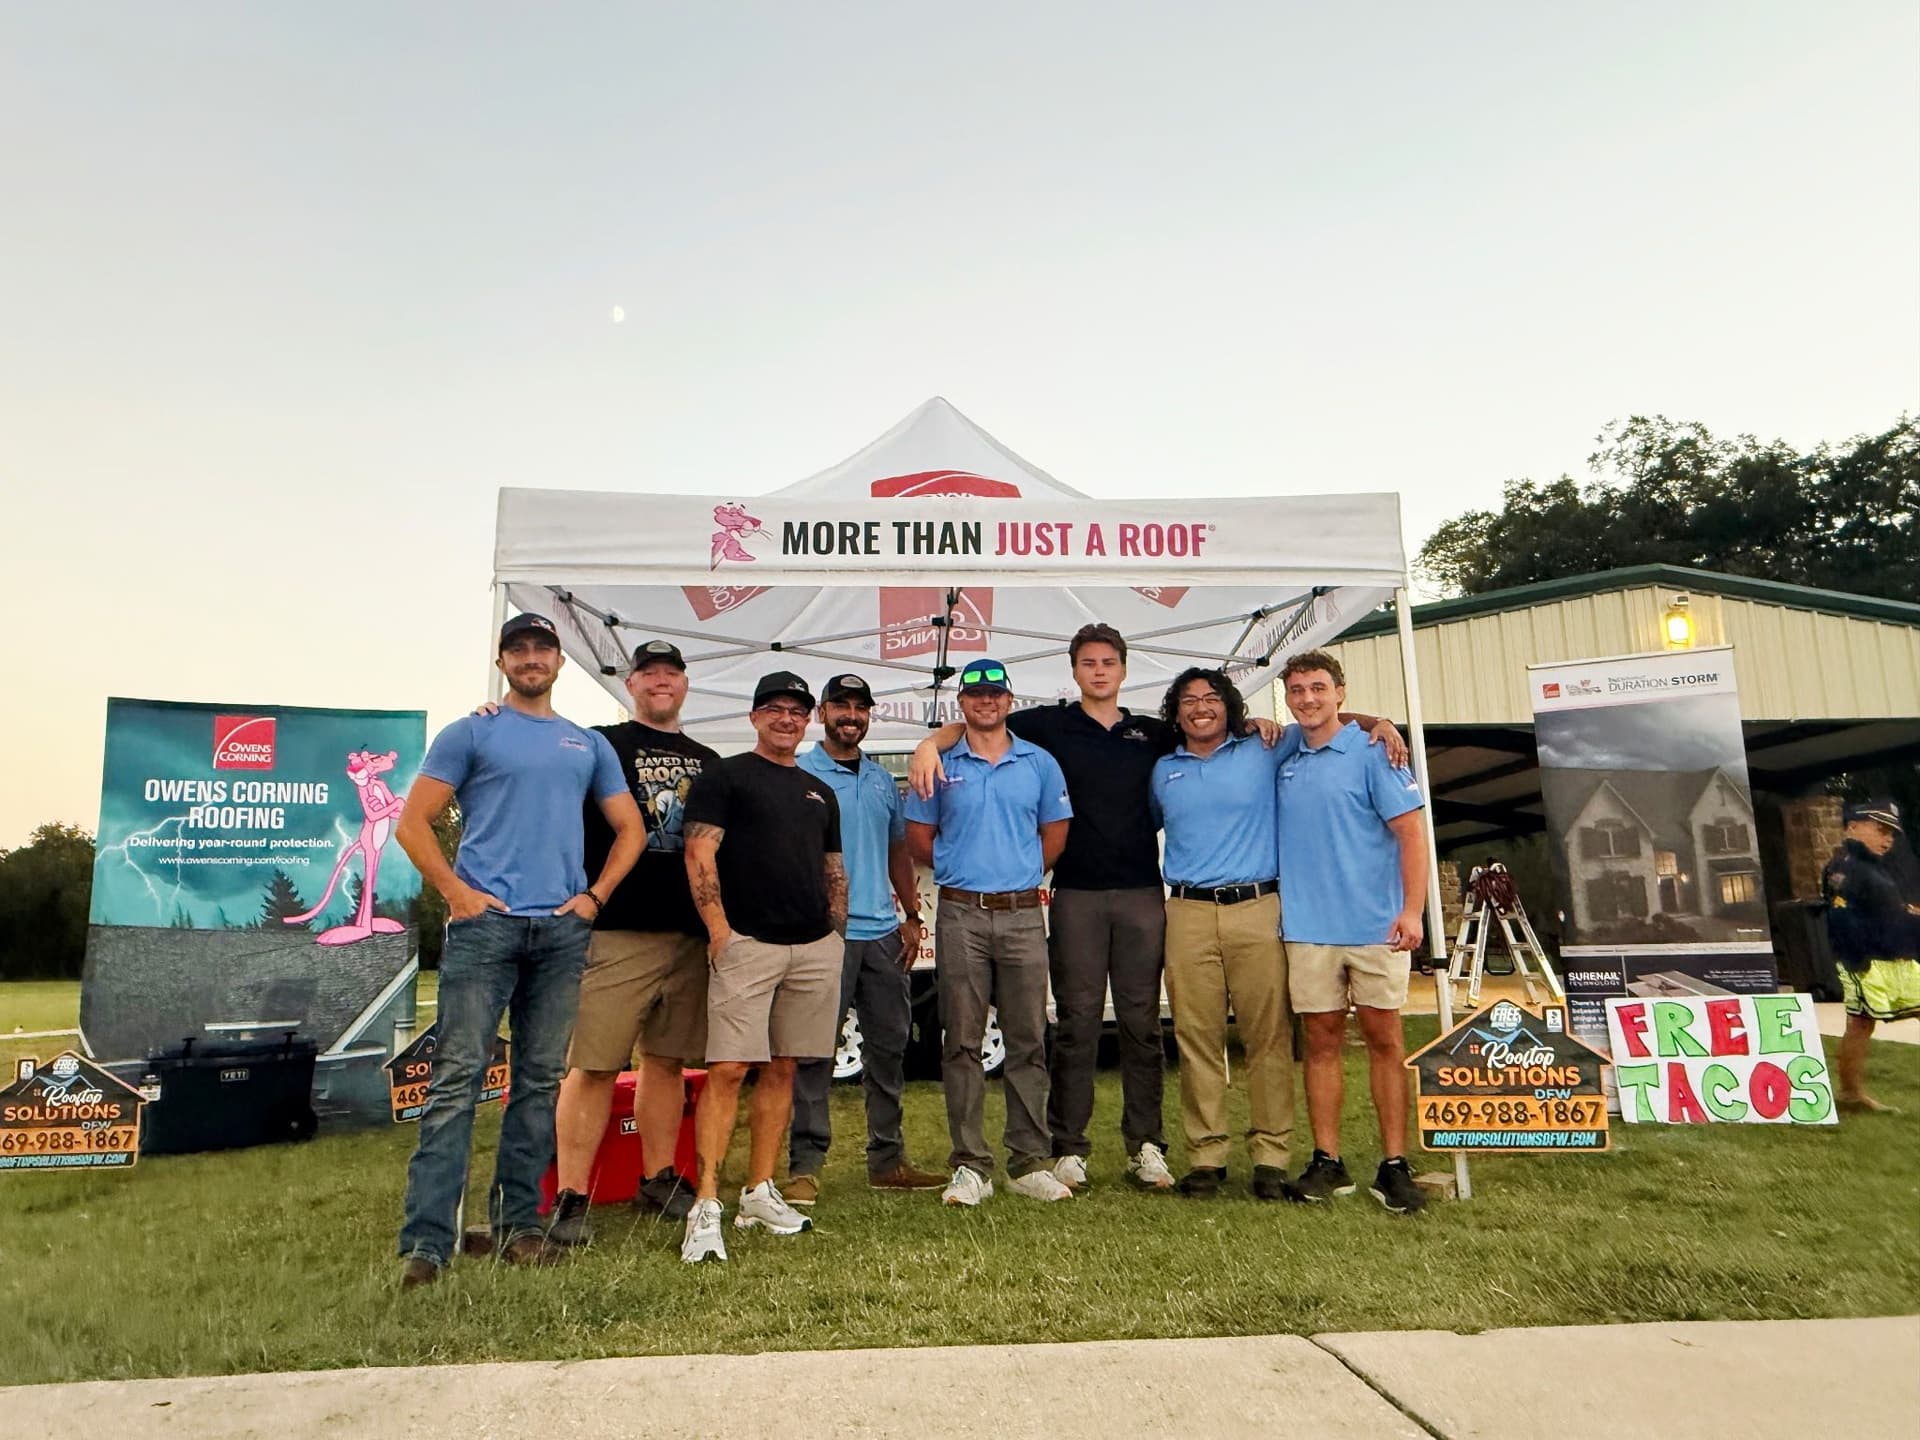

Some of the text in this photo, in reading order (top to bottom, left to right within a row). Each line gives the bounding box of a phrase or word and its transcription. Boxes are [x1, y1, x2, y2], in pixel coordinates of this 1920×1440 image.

[783, 521, 881, 555] MORE
[892, 521, 981, 555] THAN
[995, 522, 1073, 556] JUST
[1085, 523, 1107, 556] A
[1608, 678, 1668, 691] DURATION
[1671, 673, 1718, 686] STORM
[219, 752, 271, 762] CORNING
[228, 742, 271, 753] OWENS
[635, 757, 702, 768] SAVED MY
[144, 779, 329, 805] OWENS CORNING
[188, 806, 285, 829] ROOFING
[130, 837, 334, 850] Delivering year-round protection.
[1615, 996, 1805, 1057] FREE
[1481, 1042, 1554, 1071] Rooftop
[1438, 1066, 1582, 1087] SOLUTIONS
[42, 1086, 103, 1107] Rooftop
[1534, 1088, 1572, 1100] DFW
[1617, 1055, 1832, 1123] TACOS
[4, 1104, 121, 1121] SOLUTIONS
[1425, 1101, 1600, 1125] 469-988-1867
[81, 1121, 111, 1131] DFW
[0, 1130, 133, 1150] 69-988-1867
[1432, 1131, 1597, 1146] ROOFTOPSOLUTIONSDFW.COM
